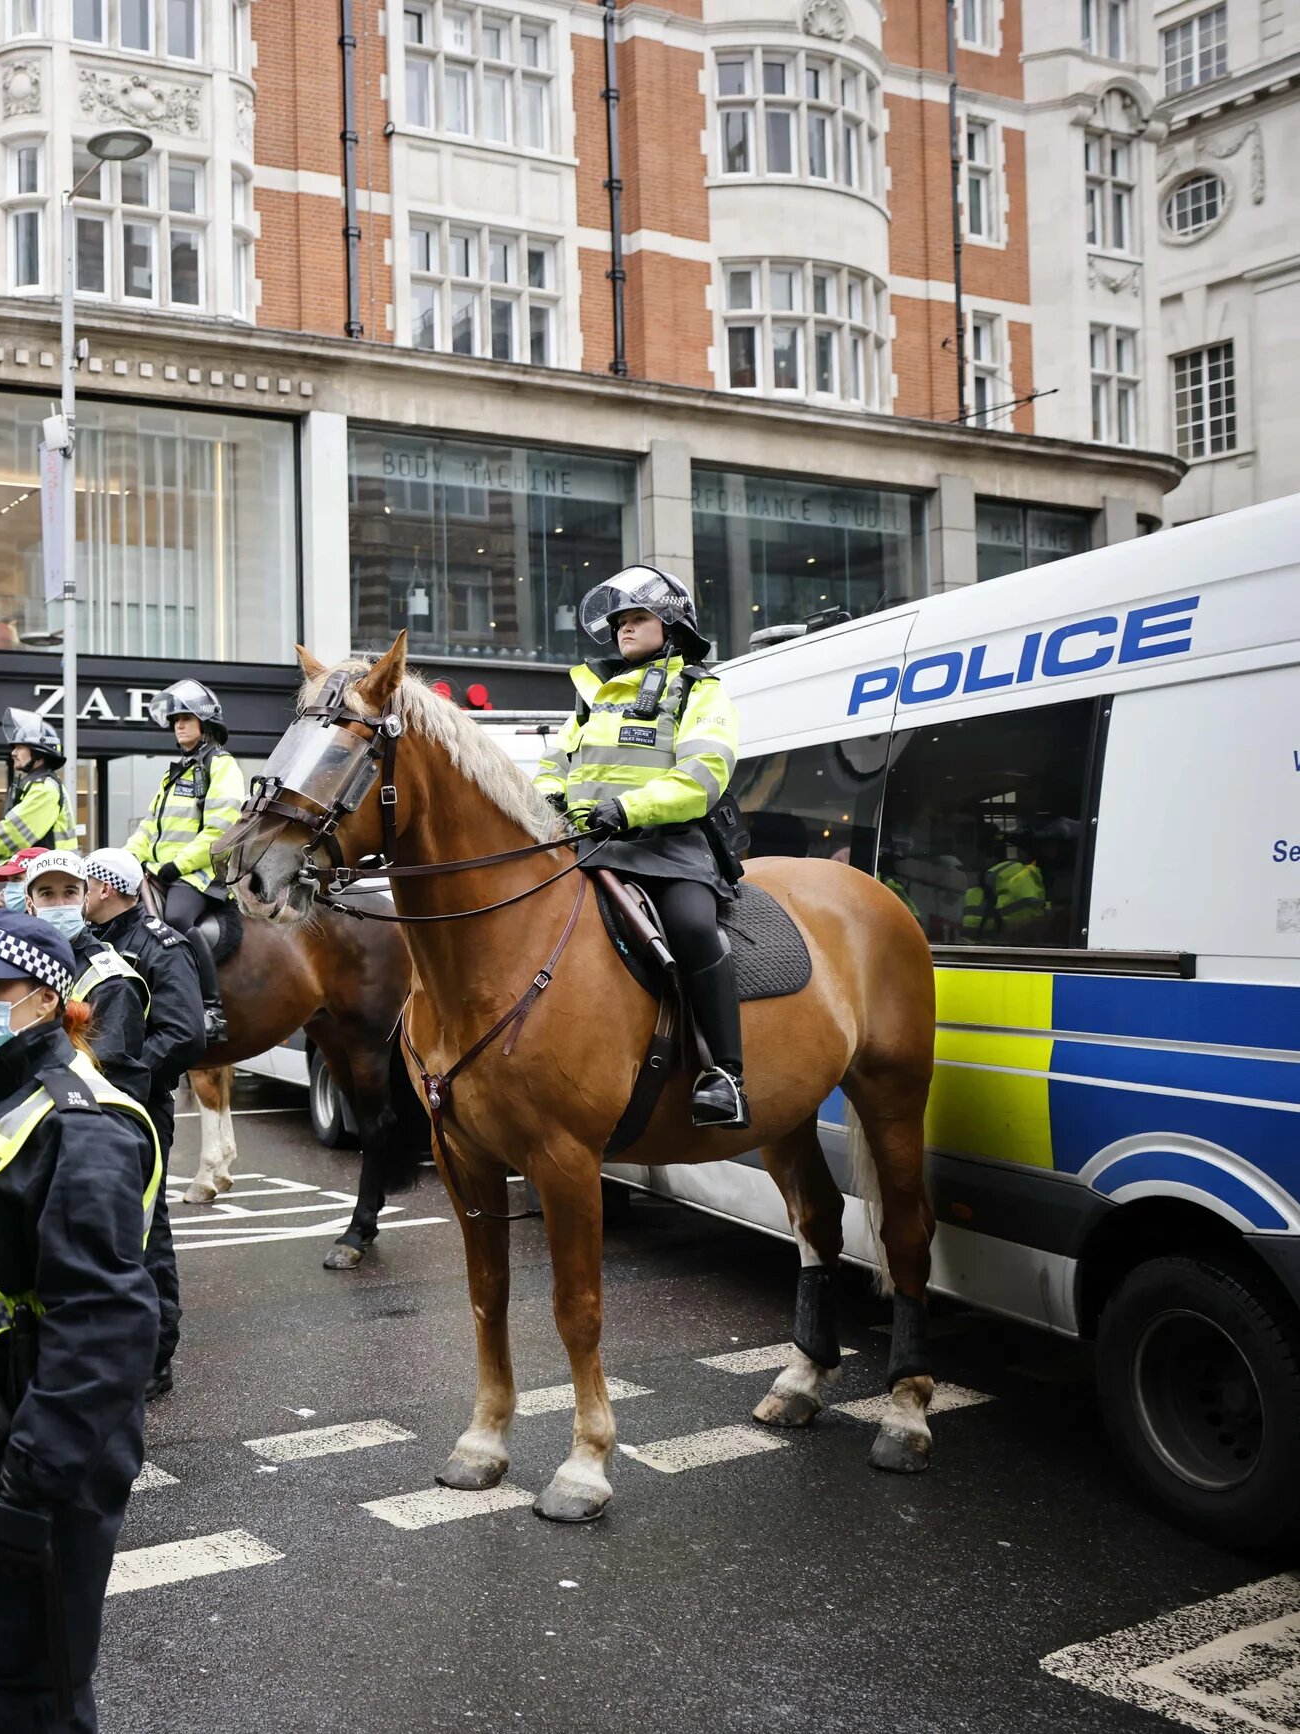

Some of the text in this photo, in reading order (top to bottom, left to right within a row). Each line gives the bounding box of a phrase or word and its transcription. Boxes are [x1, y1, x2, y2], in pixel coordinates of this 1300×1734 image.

[382, 451, 573, 495] BODY MACHINE
[847, 595, 1200, 716] POLICE
[33, 684, 162, 721] ZAR
[696, 716, 727, 726] POLICE
[36, 857, 69, 870] POLICE
